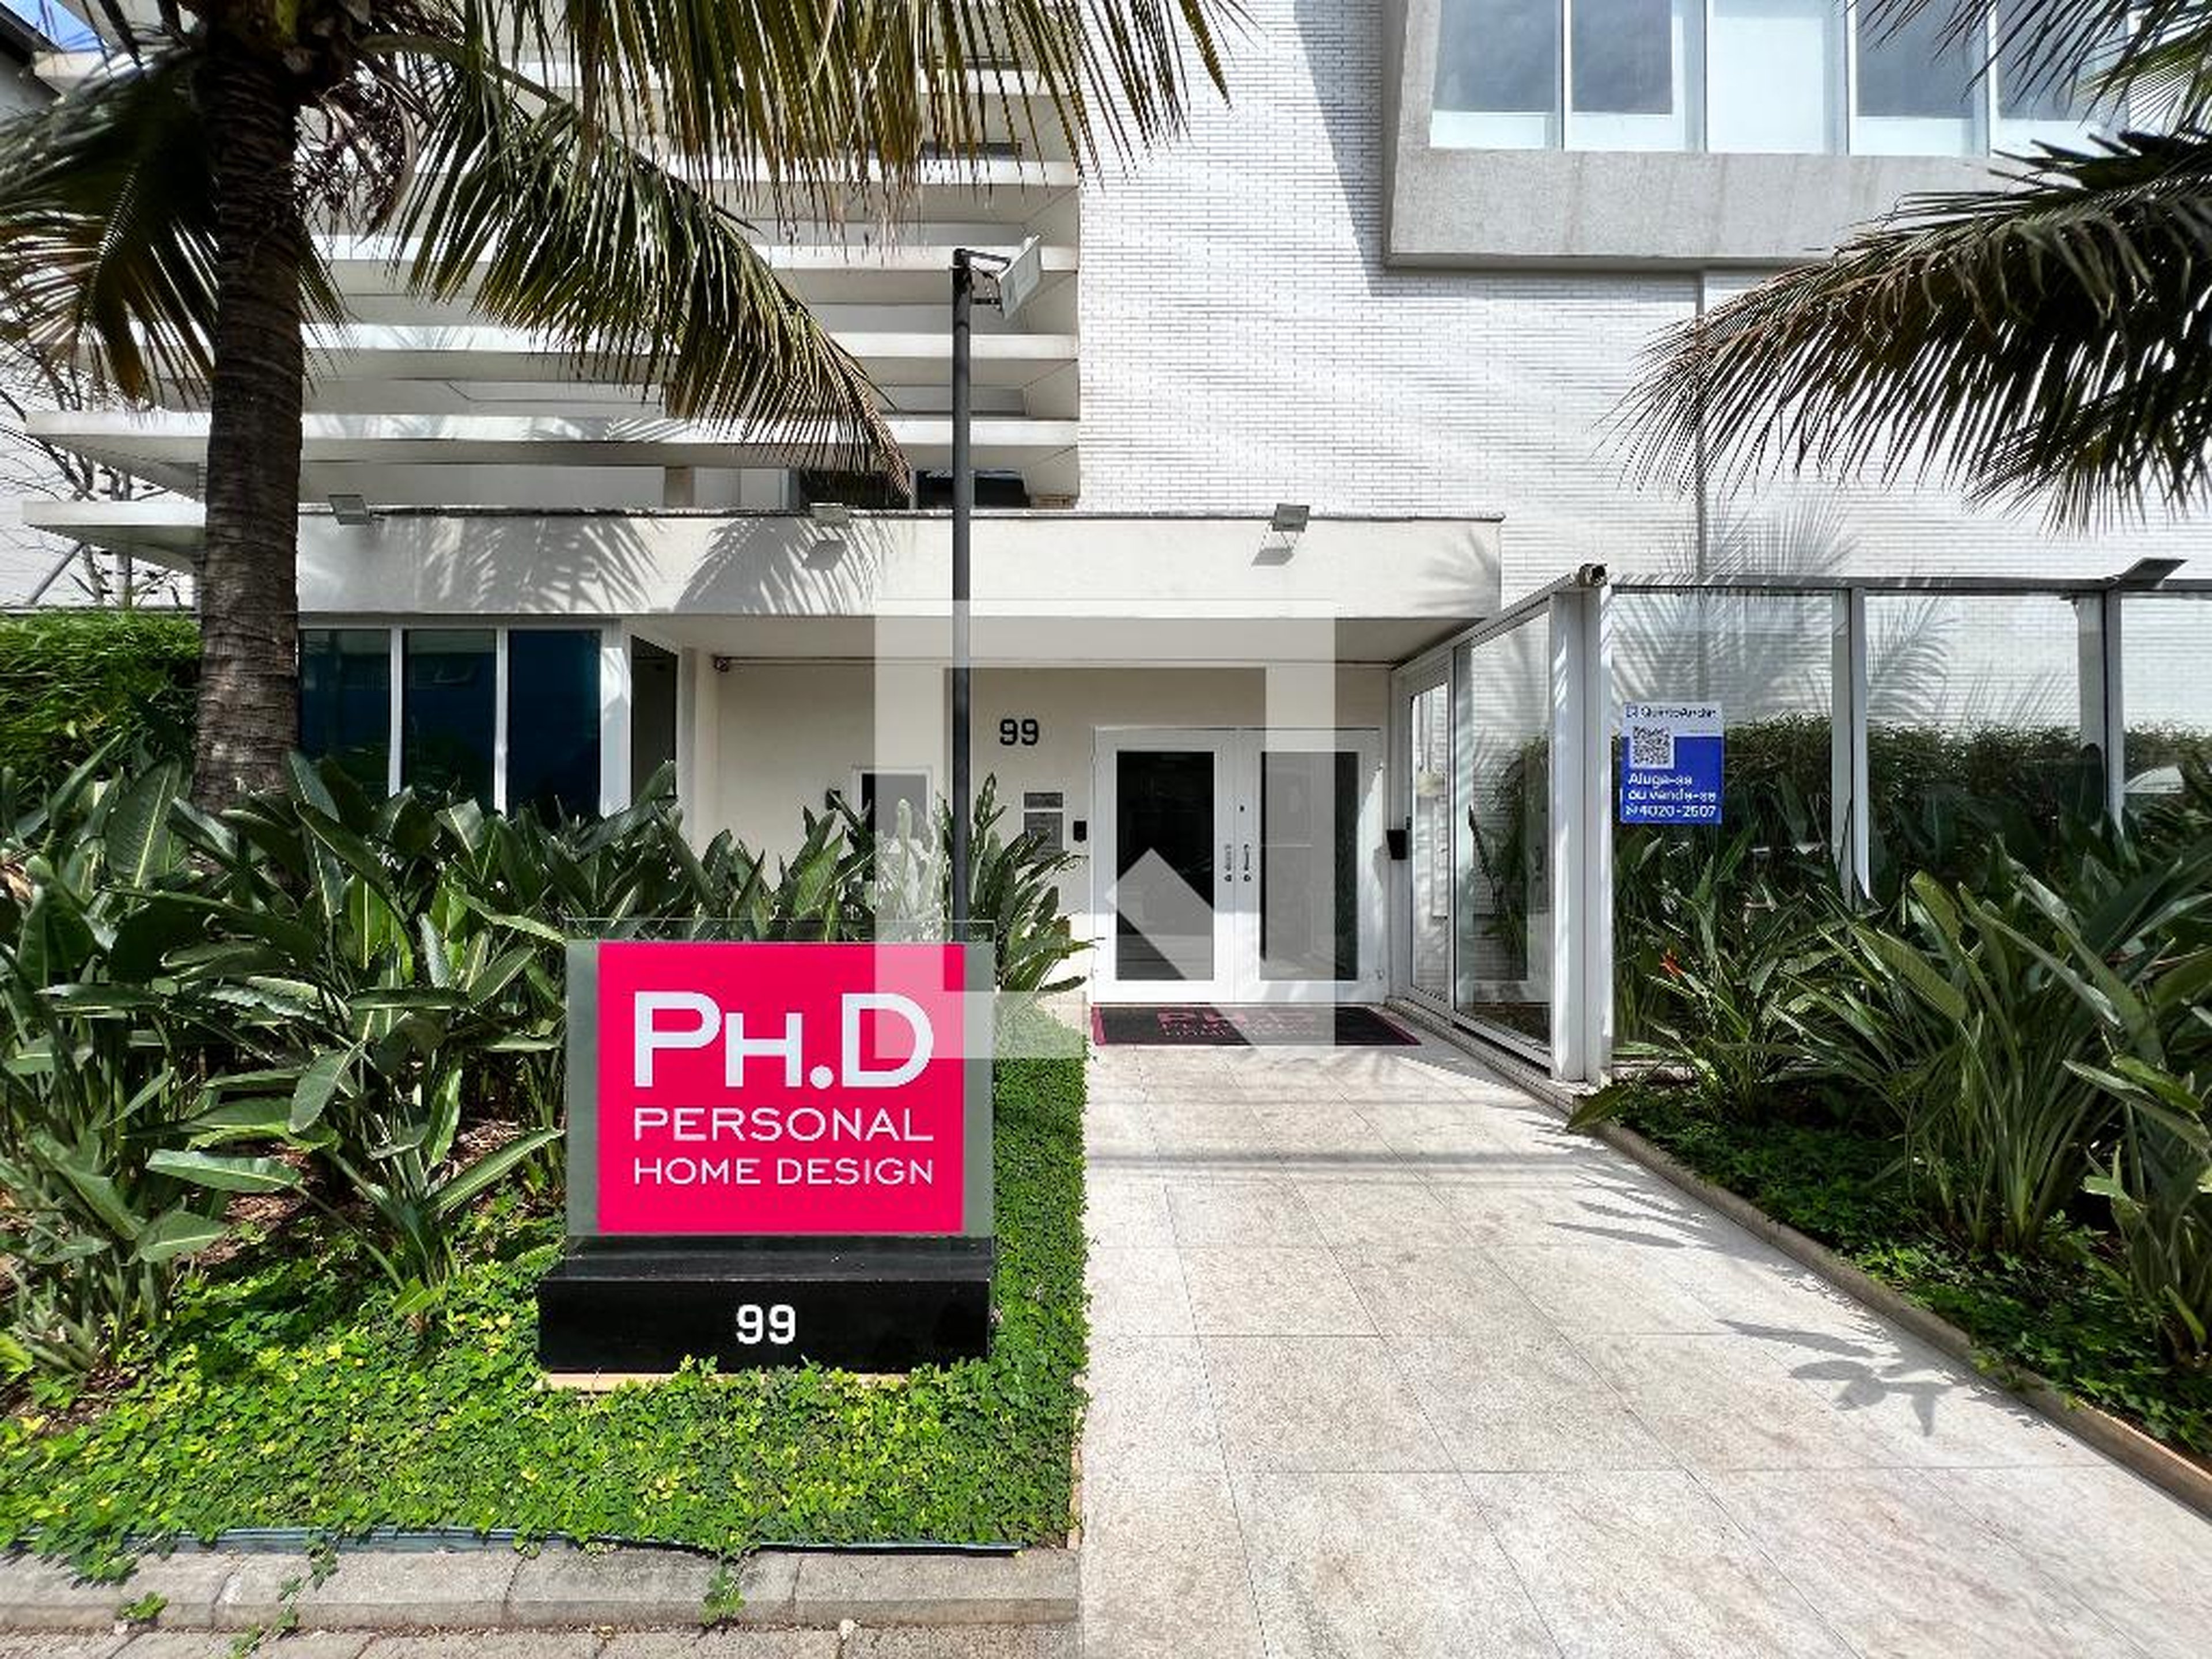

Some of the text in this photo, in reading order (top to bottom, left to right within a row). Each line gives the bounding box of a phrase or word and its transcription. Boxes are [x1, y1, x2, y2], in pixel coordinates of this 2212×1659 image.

[1000, 718, 1039, 746] 99
[1628, 791, 1647, 800] ou
[634, 991, 934, 1089] PH.D
[635, 1108, 934, 1141] PERSONAL
[635, 1157, 934, 1185] HOME DESIGN
[736, 1304, 796, 1344] 99
